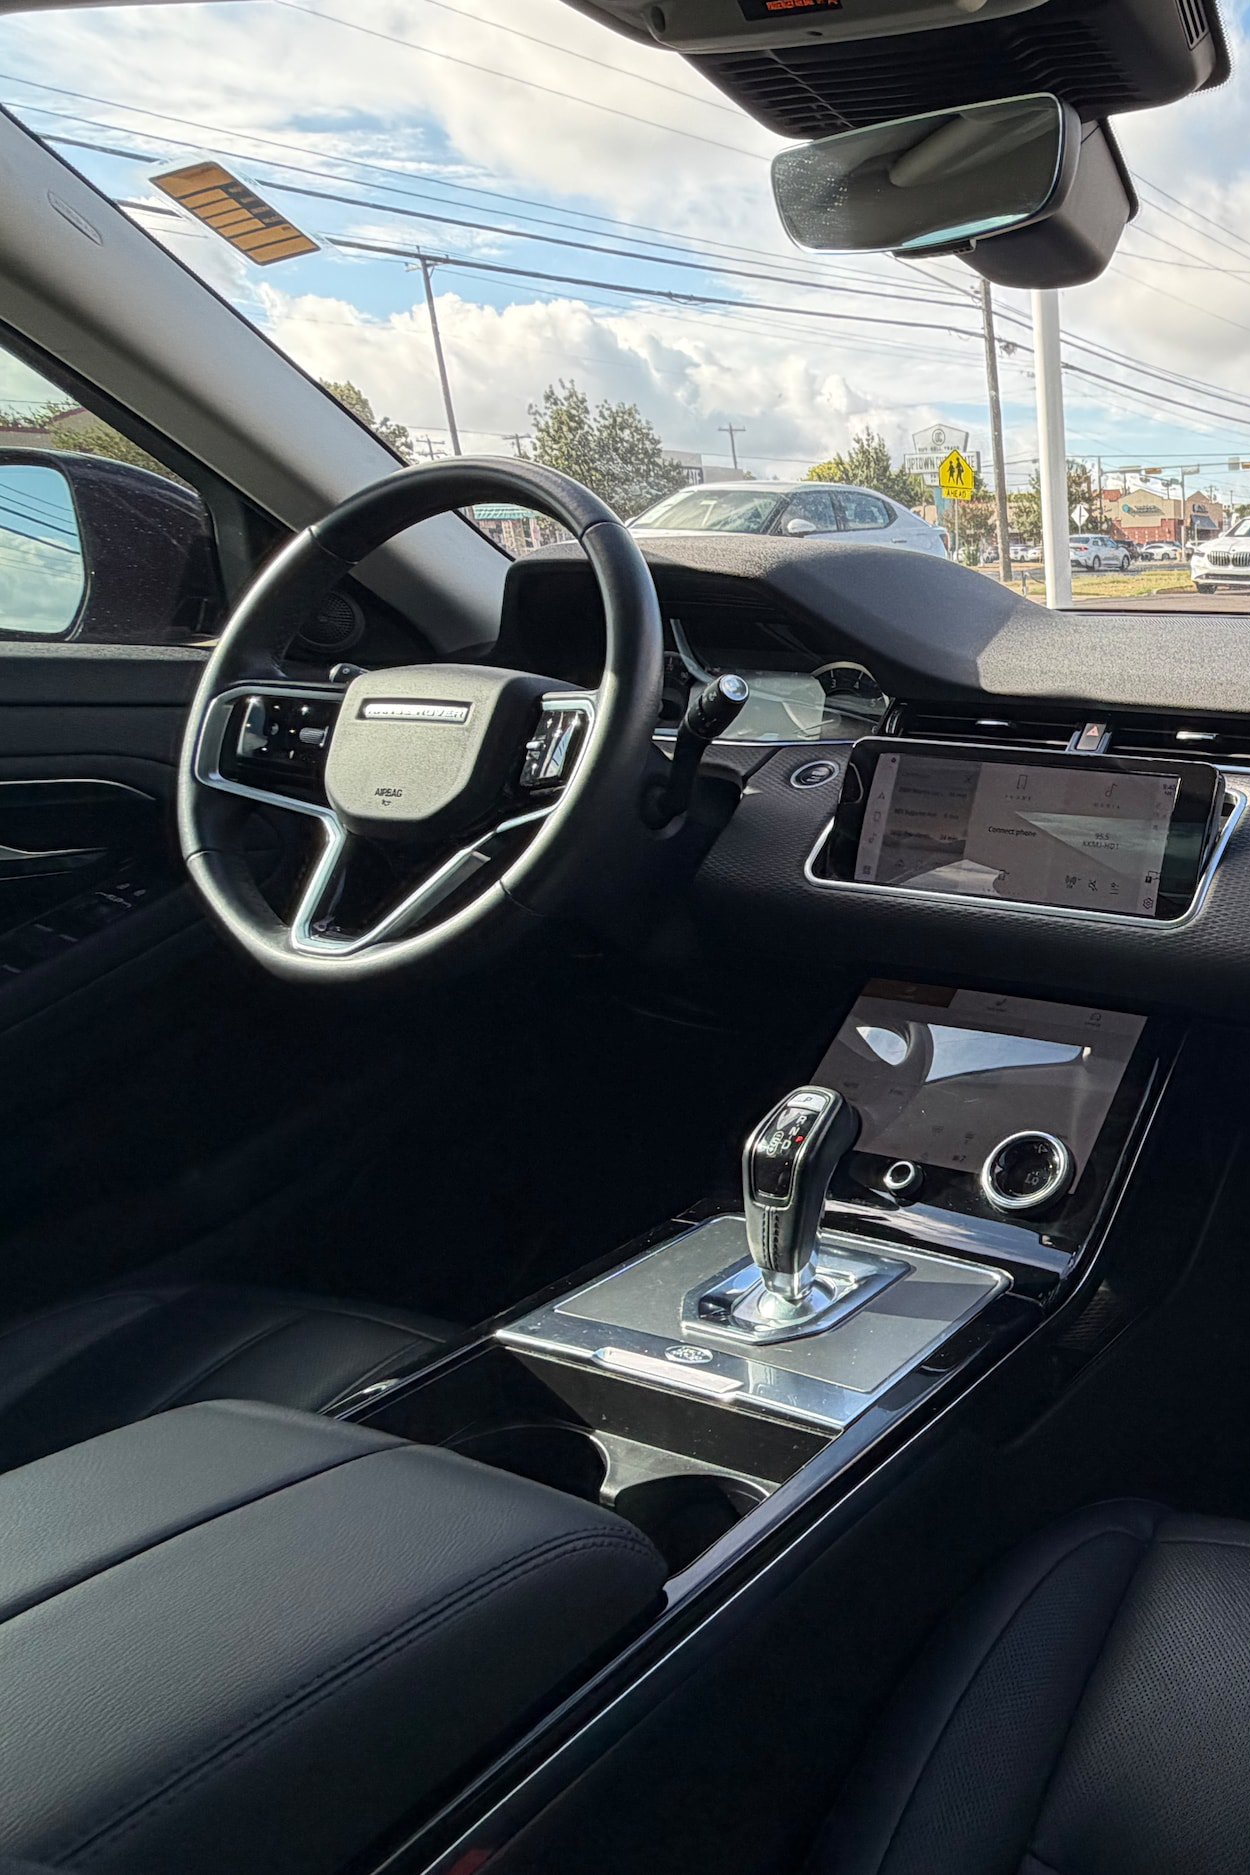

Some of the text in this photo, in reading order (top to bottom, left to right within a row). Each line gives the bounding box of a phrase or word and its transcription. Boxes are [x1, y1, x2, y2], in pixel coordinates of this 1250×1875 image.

[906, 456, 935, 470] UPTOWN
[946, 489, 967, 498] AHEAD
[374, 787, 403, 798] AIRBAG
[988, 825, 1037, 838] Connect phone
[796, 1115, 807, 1124] R
[788, 1127, 800, 1136] N
[781, 1140, 791, 1150] D
